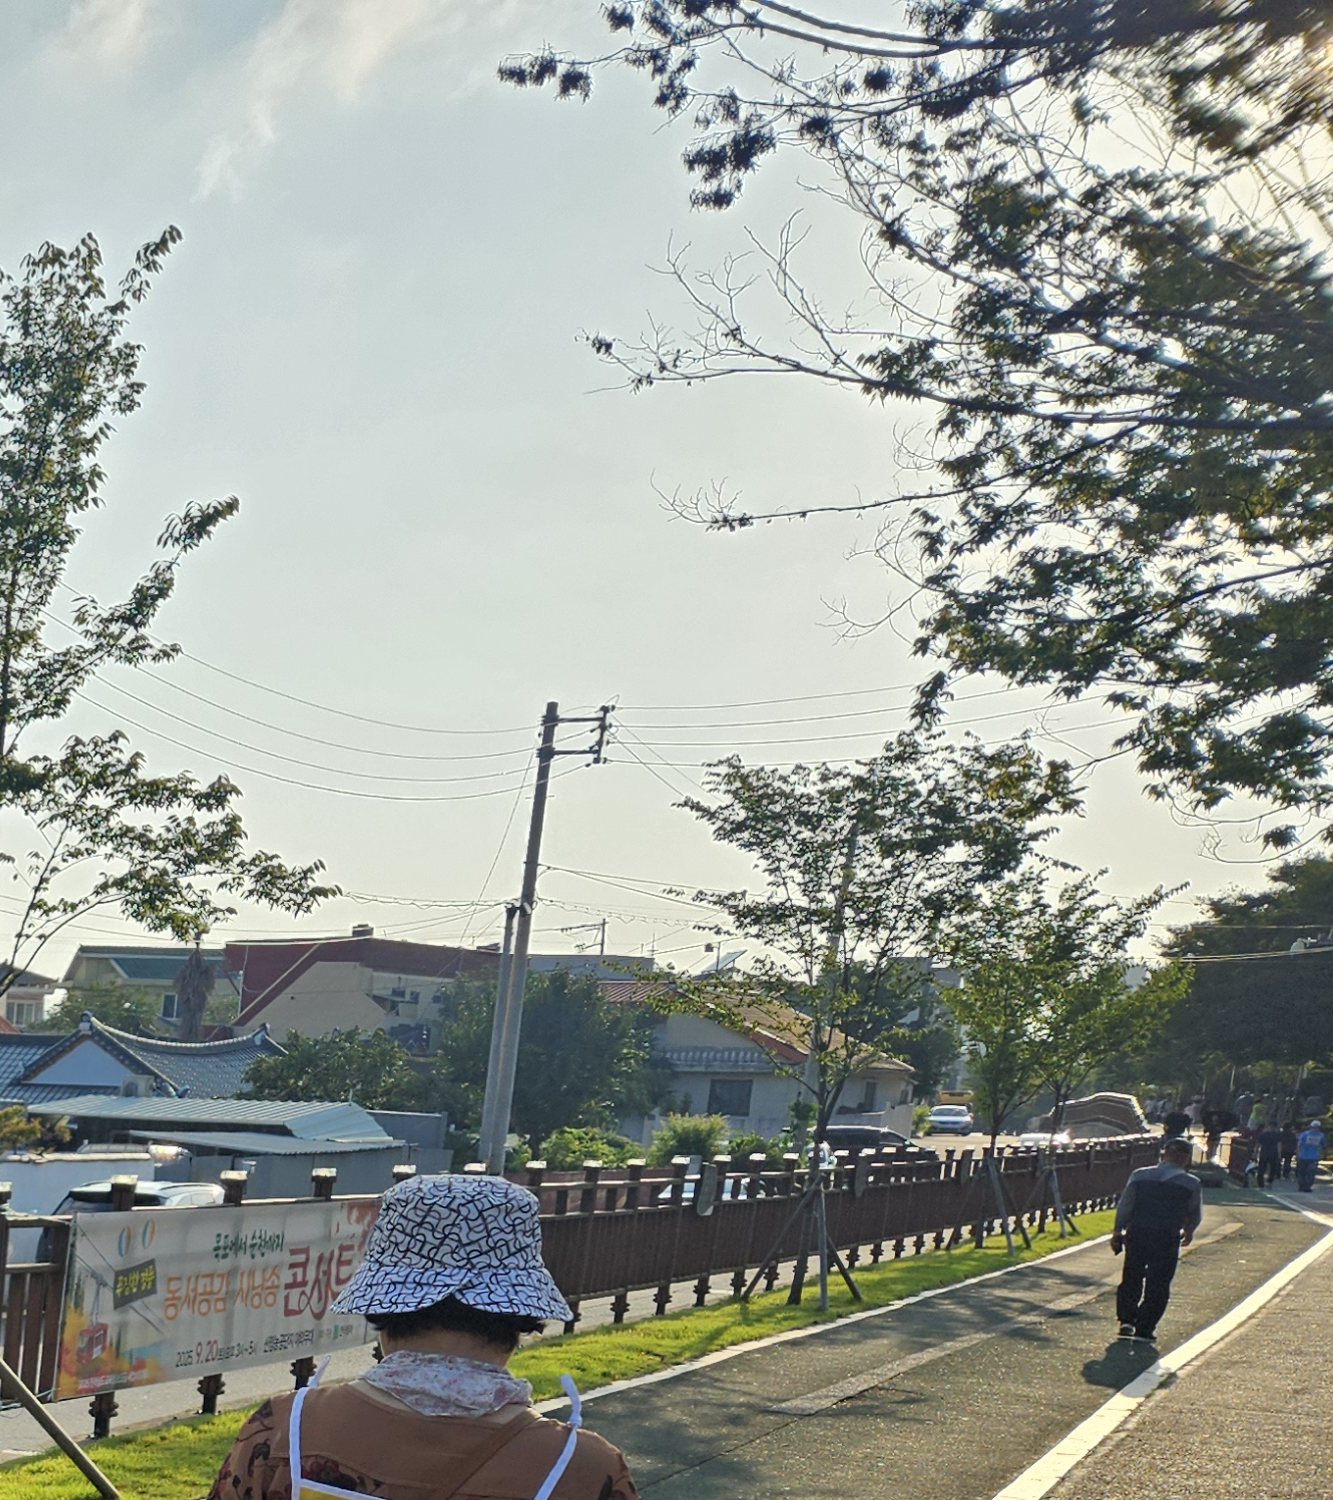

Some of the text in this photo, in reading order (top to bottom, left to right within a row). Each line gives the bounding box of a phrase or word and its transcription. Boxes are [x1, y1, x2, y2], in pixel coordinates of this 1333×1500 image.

[164, 1242, 356, 1321] 동서공감 시낭송 콘서트
